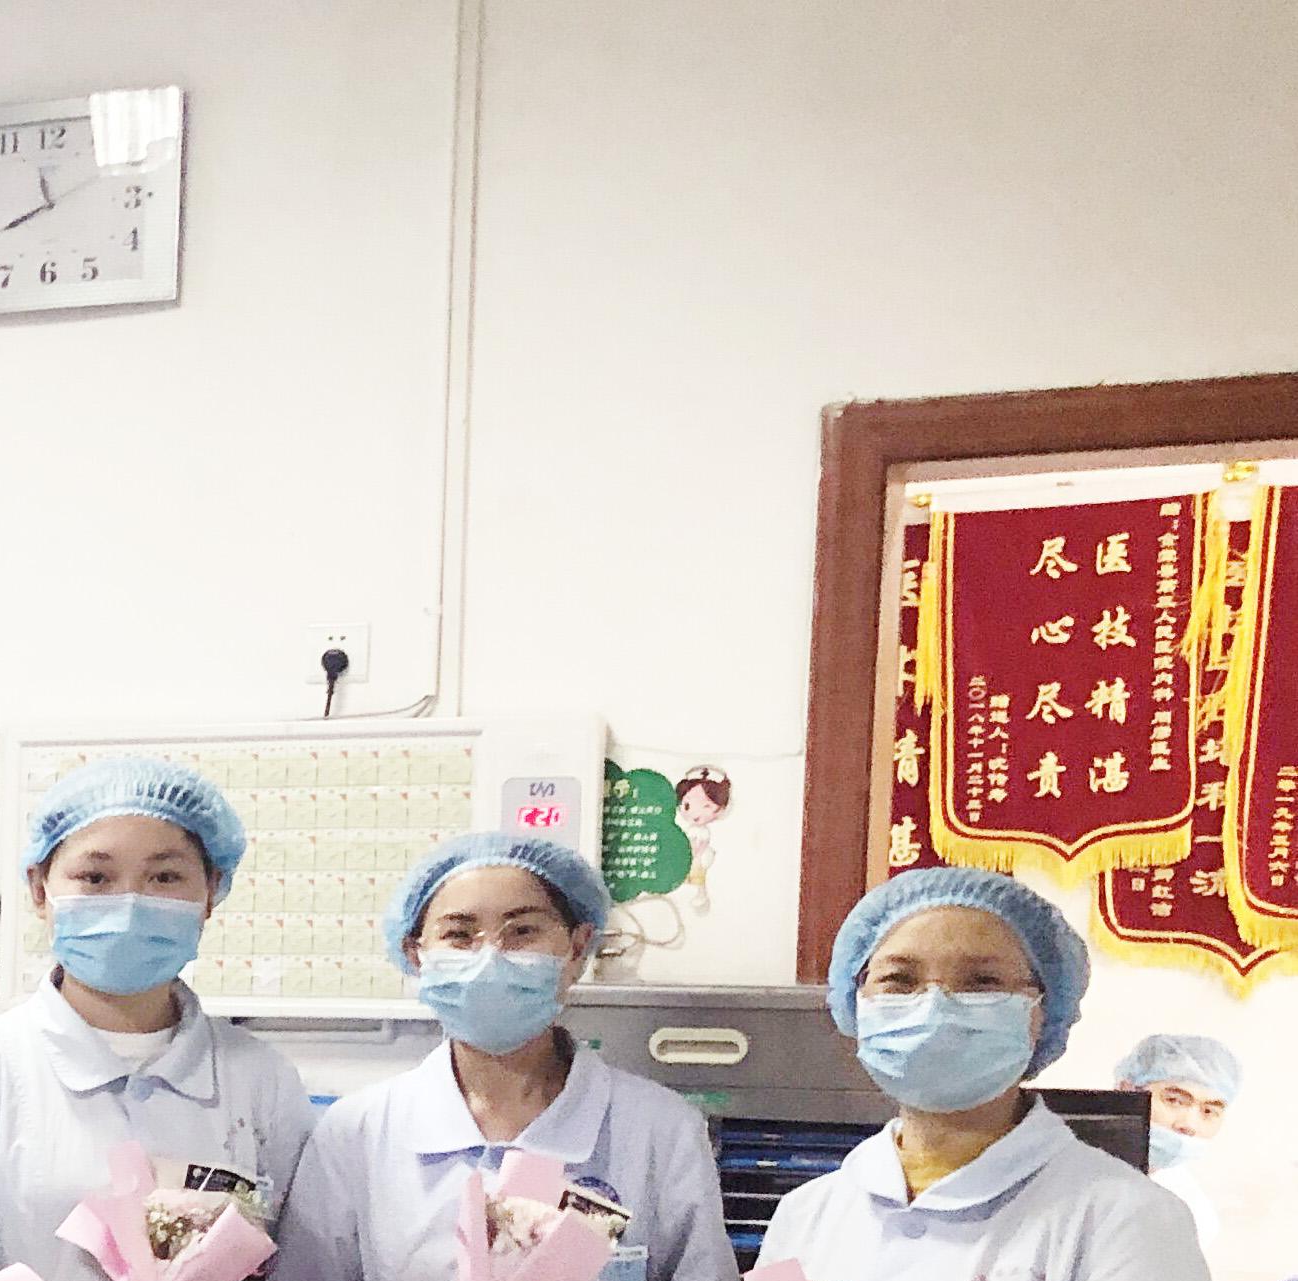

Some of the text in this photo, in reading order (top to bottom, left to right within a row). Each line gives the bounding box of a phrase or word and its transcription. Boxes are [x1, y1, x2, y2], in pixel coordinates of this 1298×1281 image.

[38, 127, 67, 150] 12
[124, 185, 143, 209] 3
[122, 227, 140, 252] 4
[39, 261, 58, 284] 6
[81, 257, 99, 281] 5
[1025, 536, 1079, 798] 尽心尽责
[1085, 532, 1137, 793] 医技精湛
